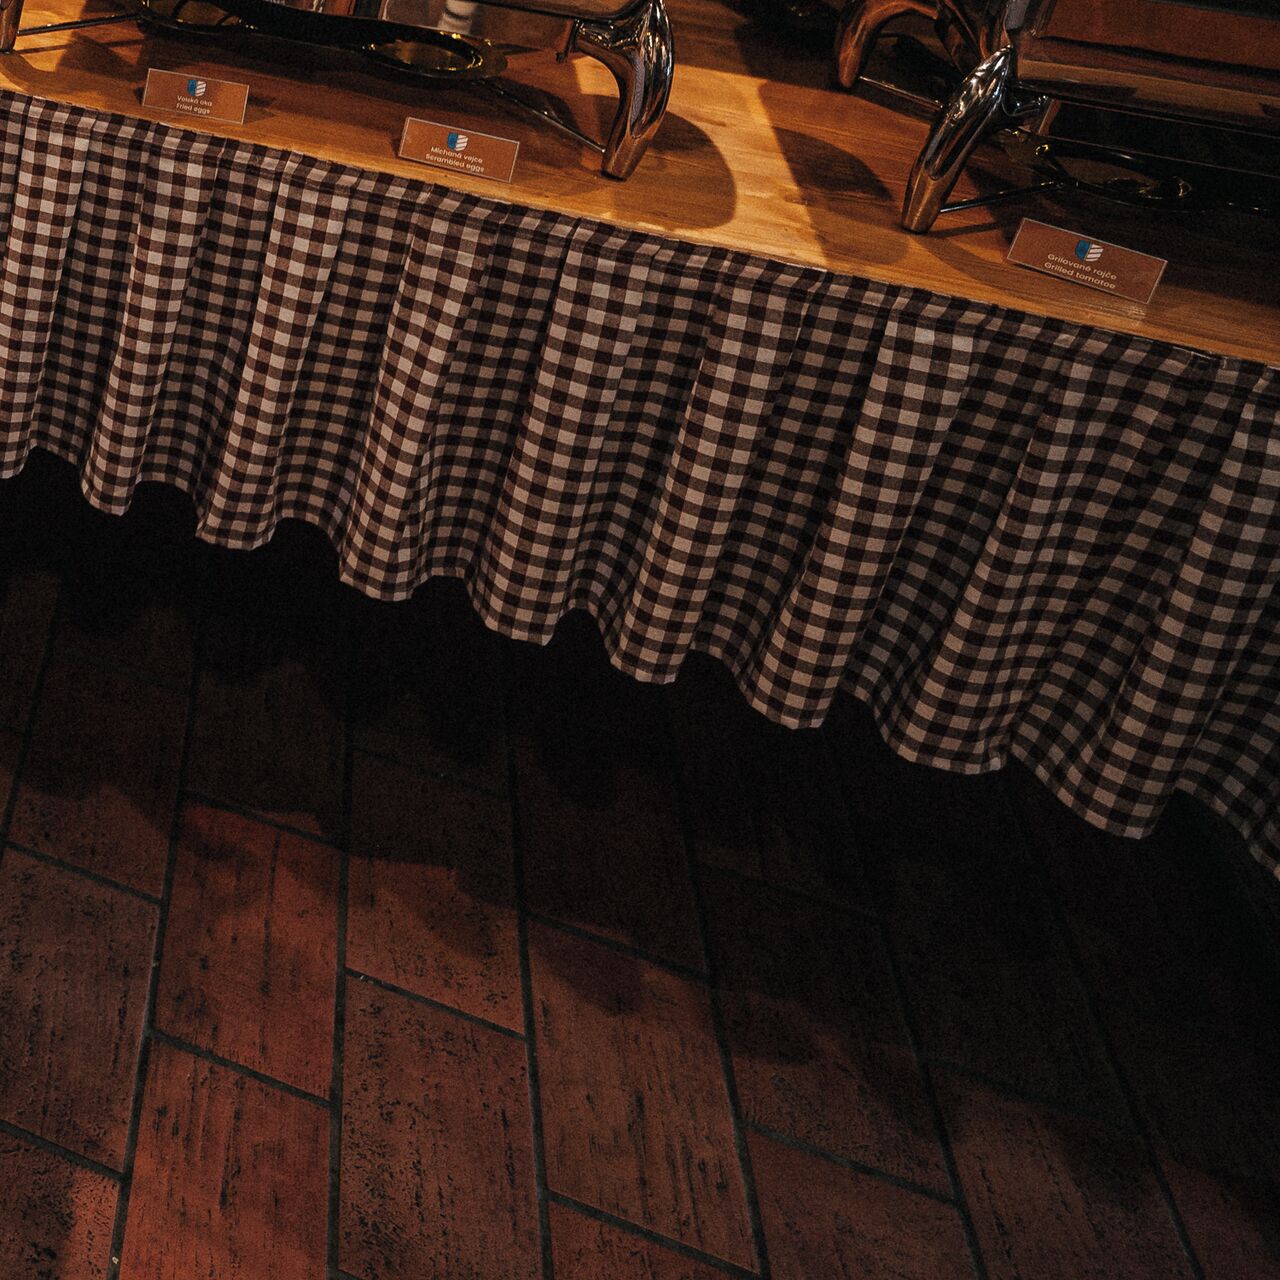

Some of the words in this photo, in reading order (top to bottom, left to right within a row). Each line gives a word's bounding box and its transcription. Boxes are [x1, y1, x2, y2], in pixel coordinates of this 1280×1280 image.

[426, 153, 465, 167] Scrambled
[466, 163, 485, 172] eggs
[463, 154, 483, 163] vejce
[1044, 262, 1074, 276] Grilled
[1076, 272, 1116, 289] tomatoe
